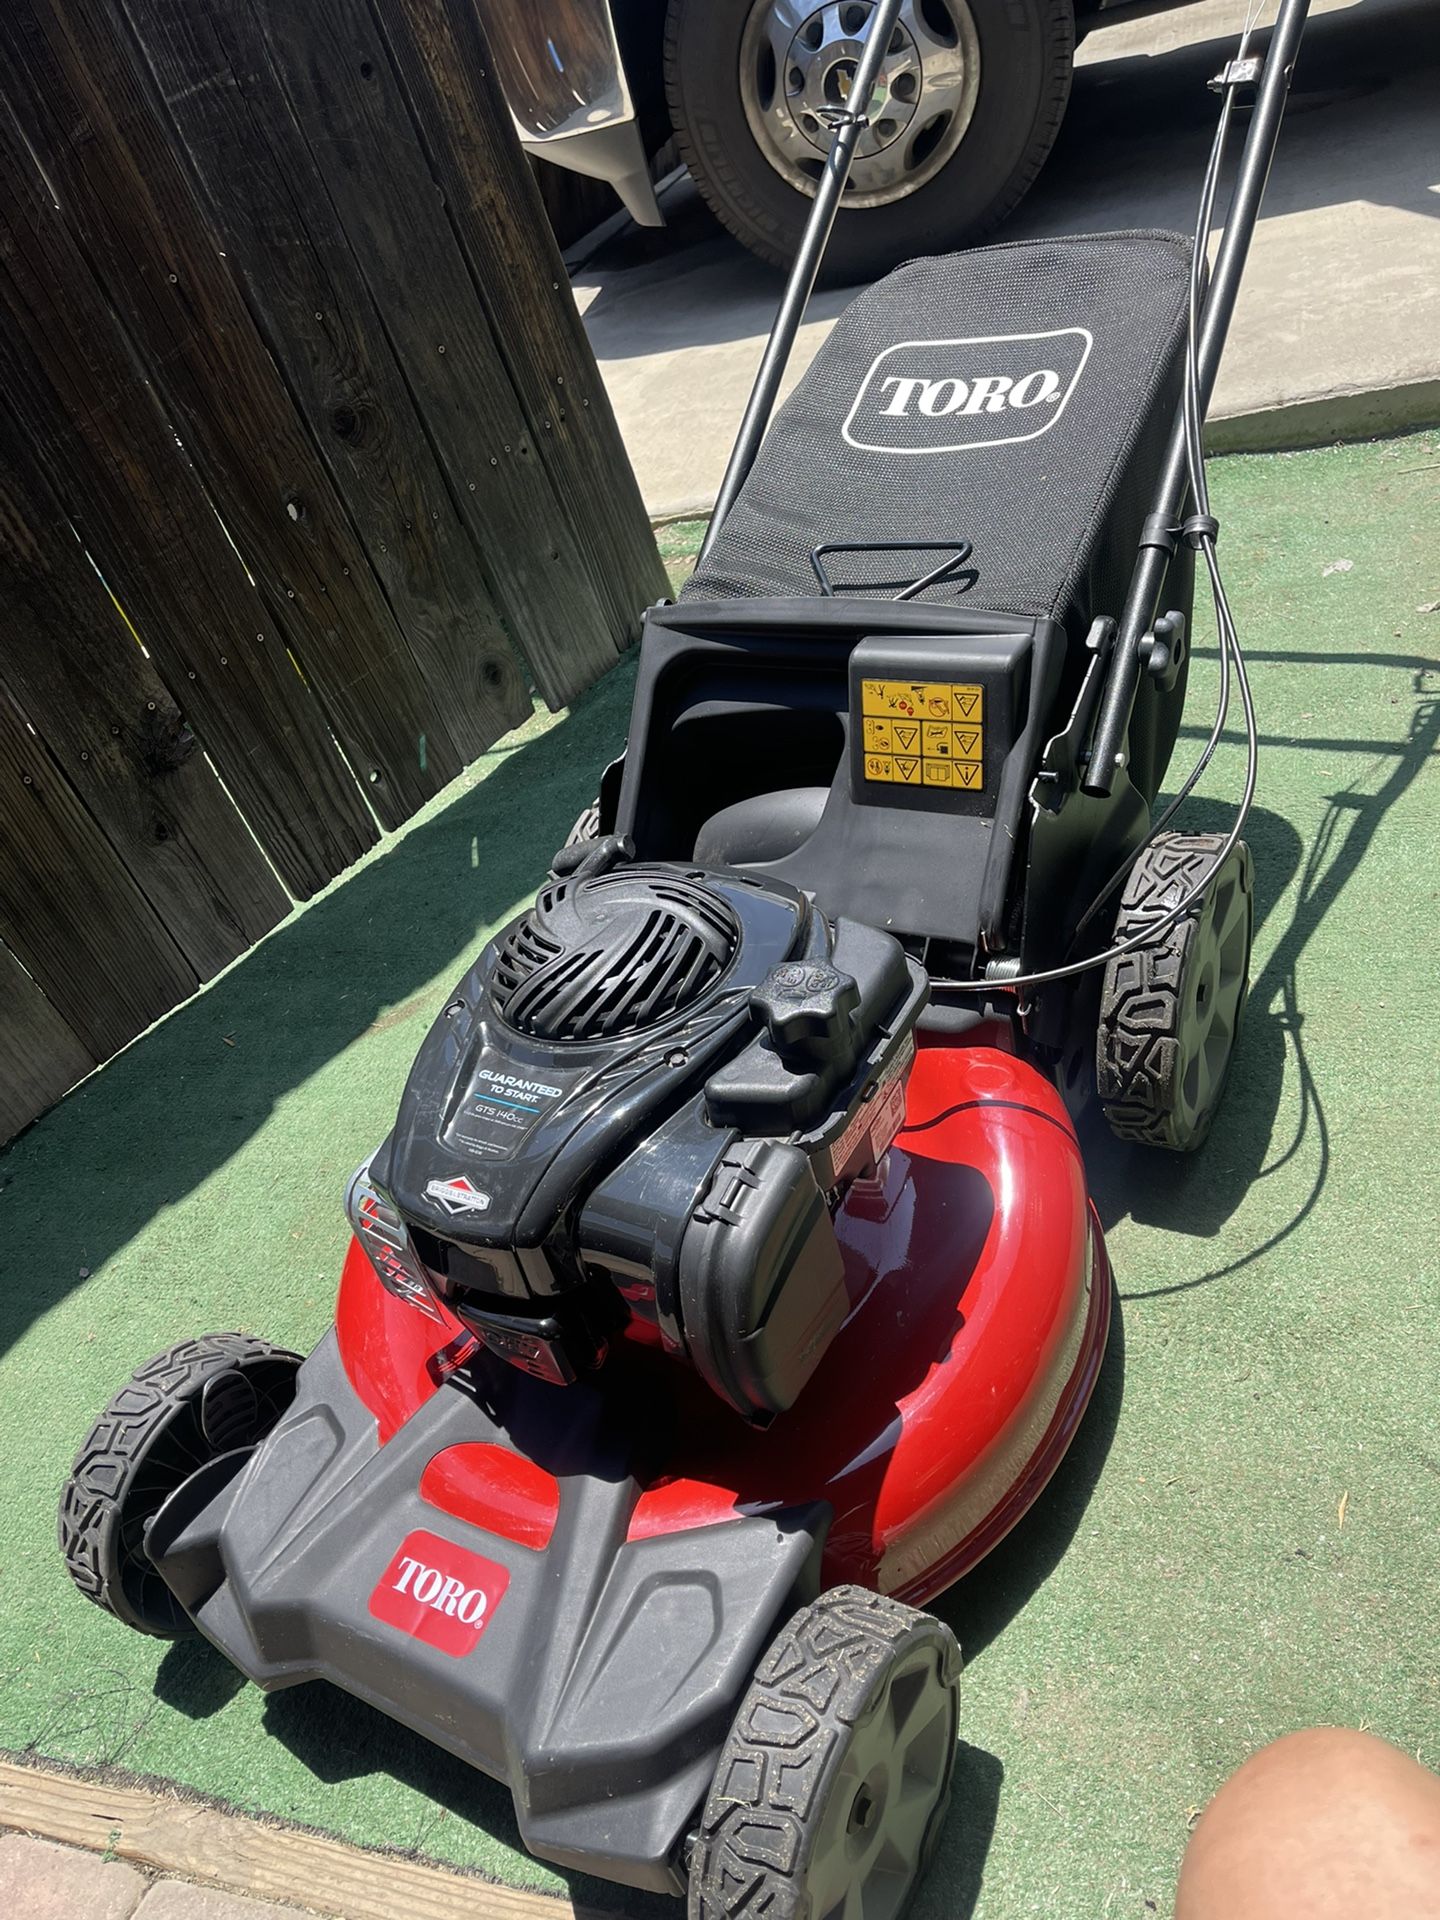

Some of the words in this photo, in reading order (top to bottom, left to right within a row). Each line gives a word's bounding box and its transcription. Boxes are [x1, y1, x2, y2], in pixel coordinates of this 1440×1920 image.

[479, 1069, 563, 1098] GUARANTEED
[490, 1084, 504, 1094] TO
[475, 1104, 496, 1116] GTS
[496, 1109, 524, 1124] 140cc
